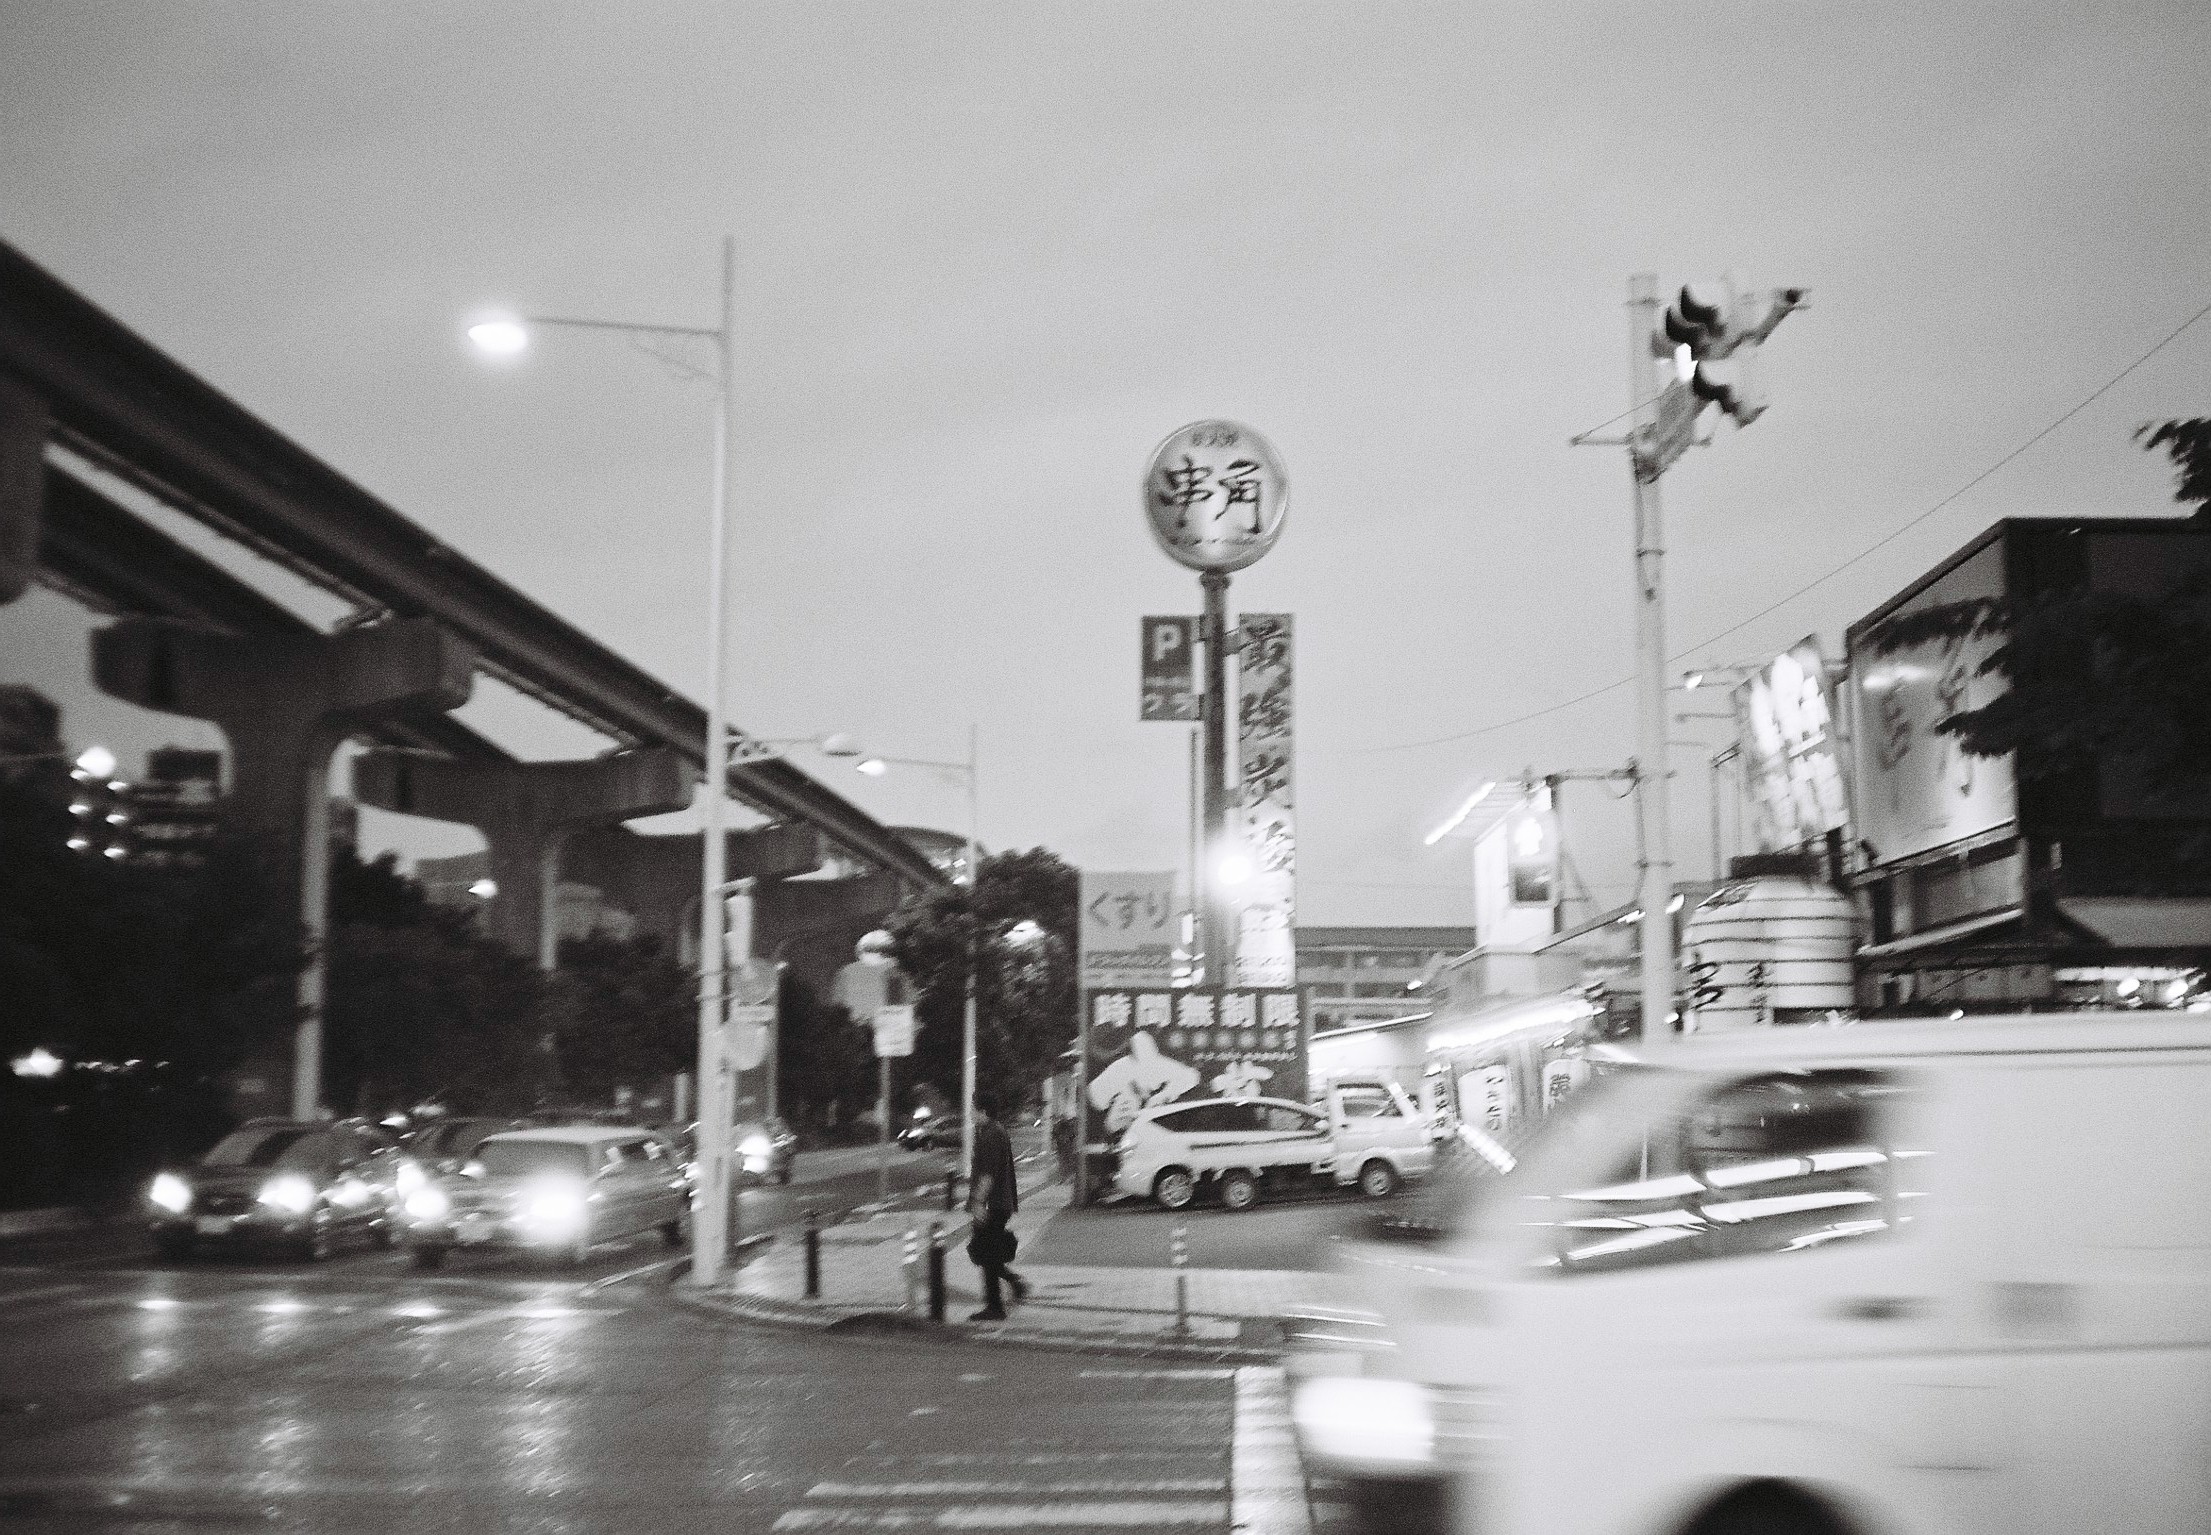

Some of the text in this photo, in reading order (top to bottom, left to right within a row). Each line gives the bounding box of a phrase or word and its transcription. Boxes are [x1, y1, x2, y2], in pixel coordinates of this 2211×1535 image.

[1159, 454, 1261, 534] 串角
[1153, 624, 1179, 660] P
[1088, 891, 1170, 929] くすり
[1093, 992, 1300, 1028] 時間無制限
